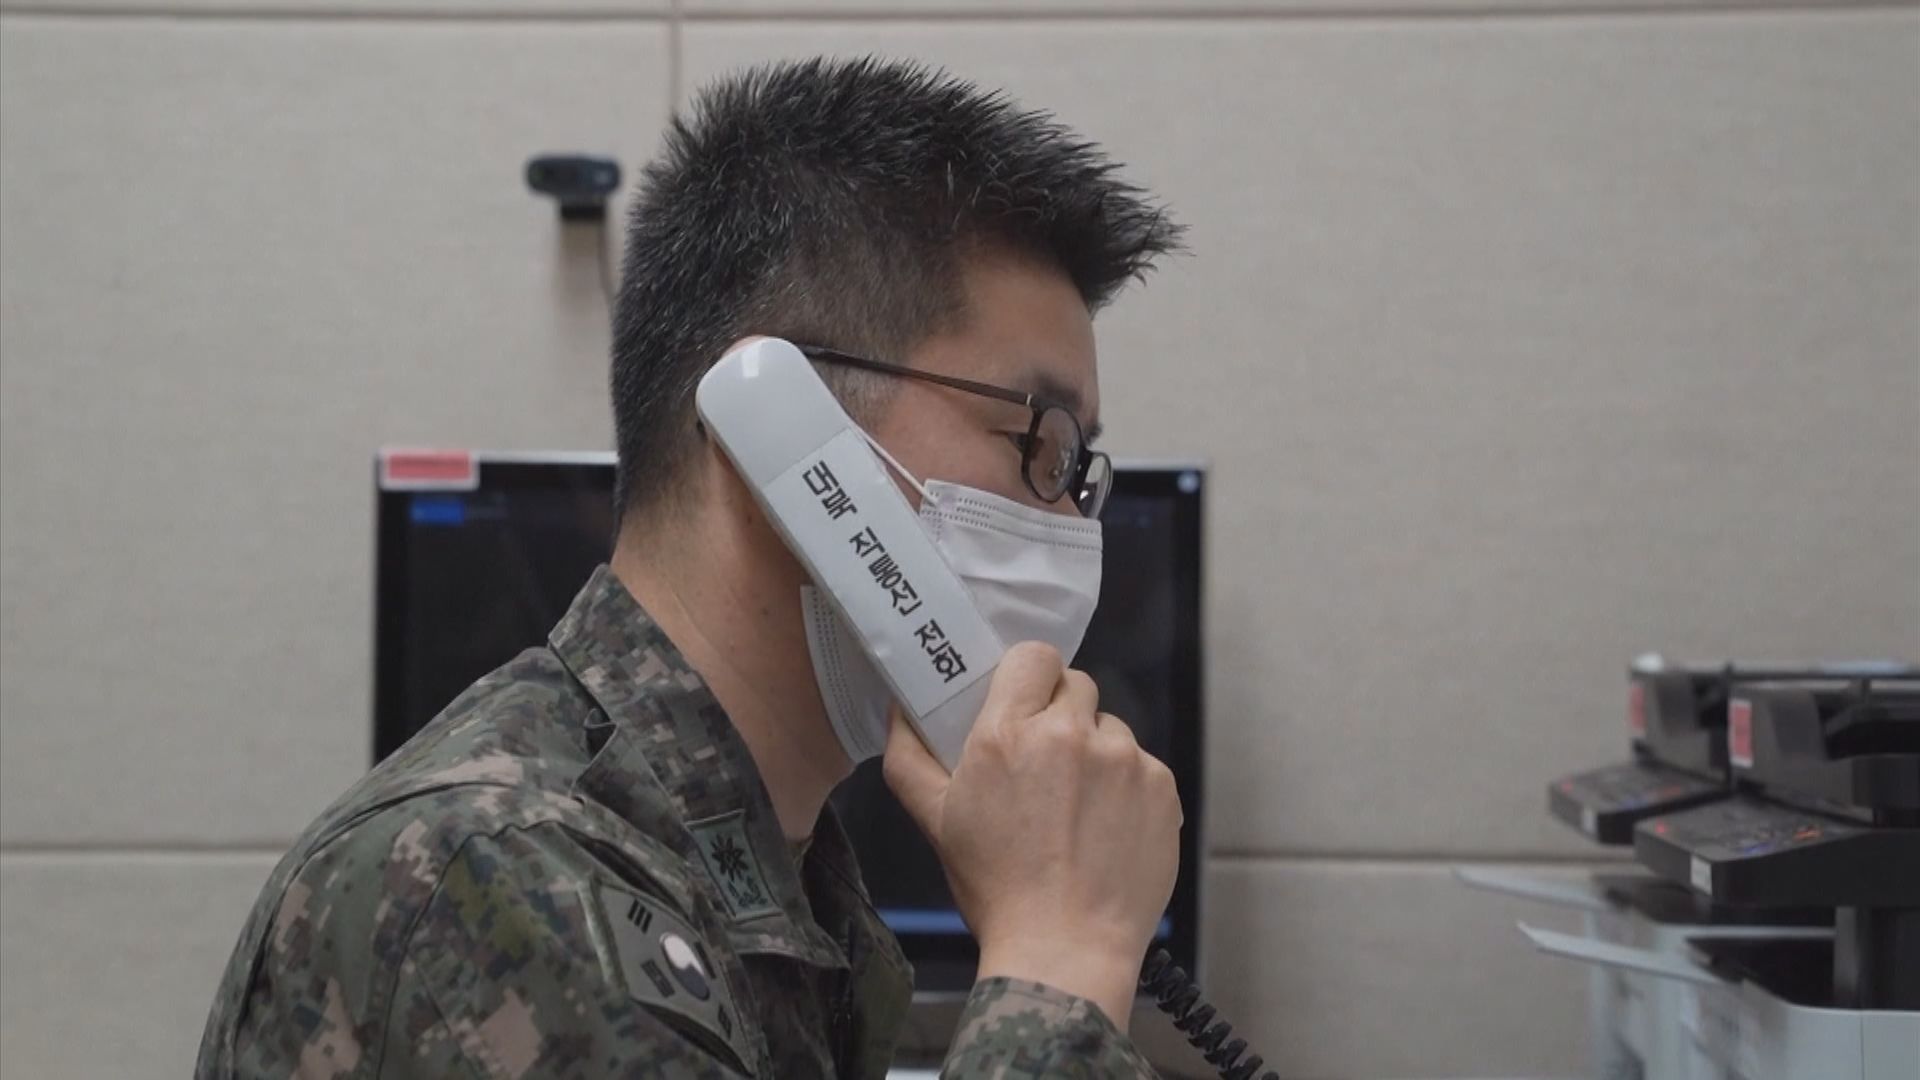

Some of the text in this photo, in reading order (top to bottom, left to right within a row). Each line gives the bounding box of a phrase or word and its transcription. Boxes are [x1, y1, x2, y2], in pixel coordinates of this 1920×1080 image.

[802, 460, 967, 683] 대북 직통선 전화
